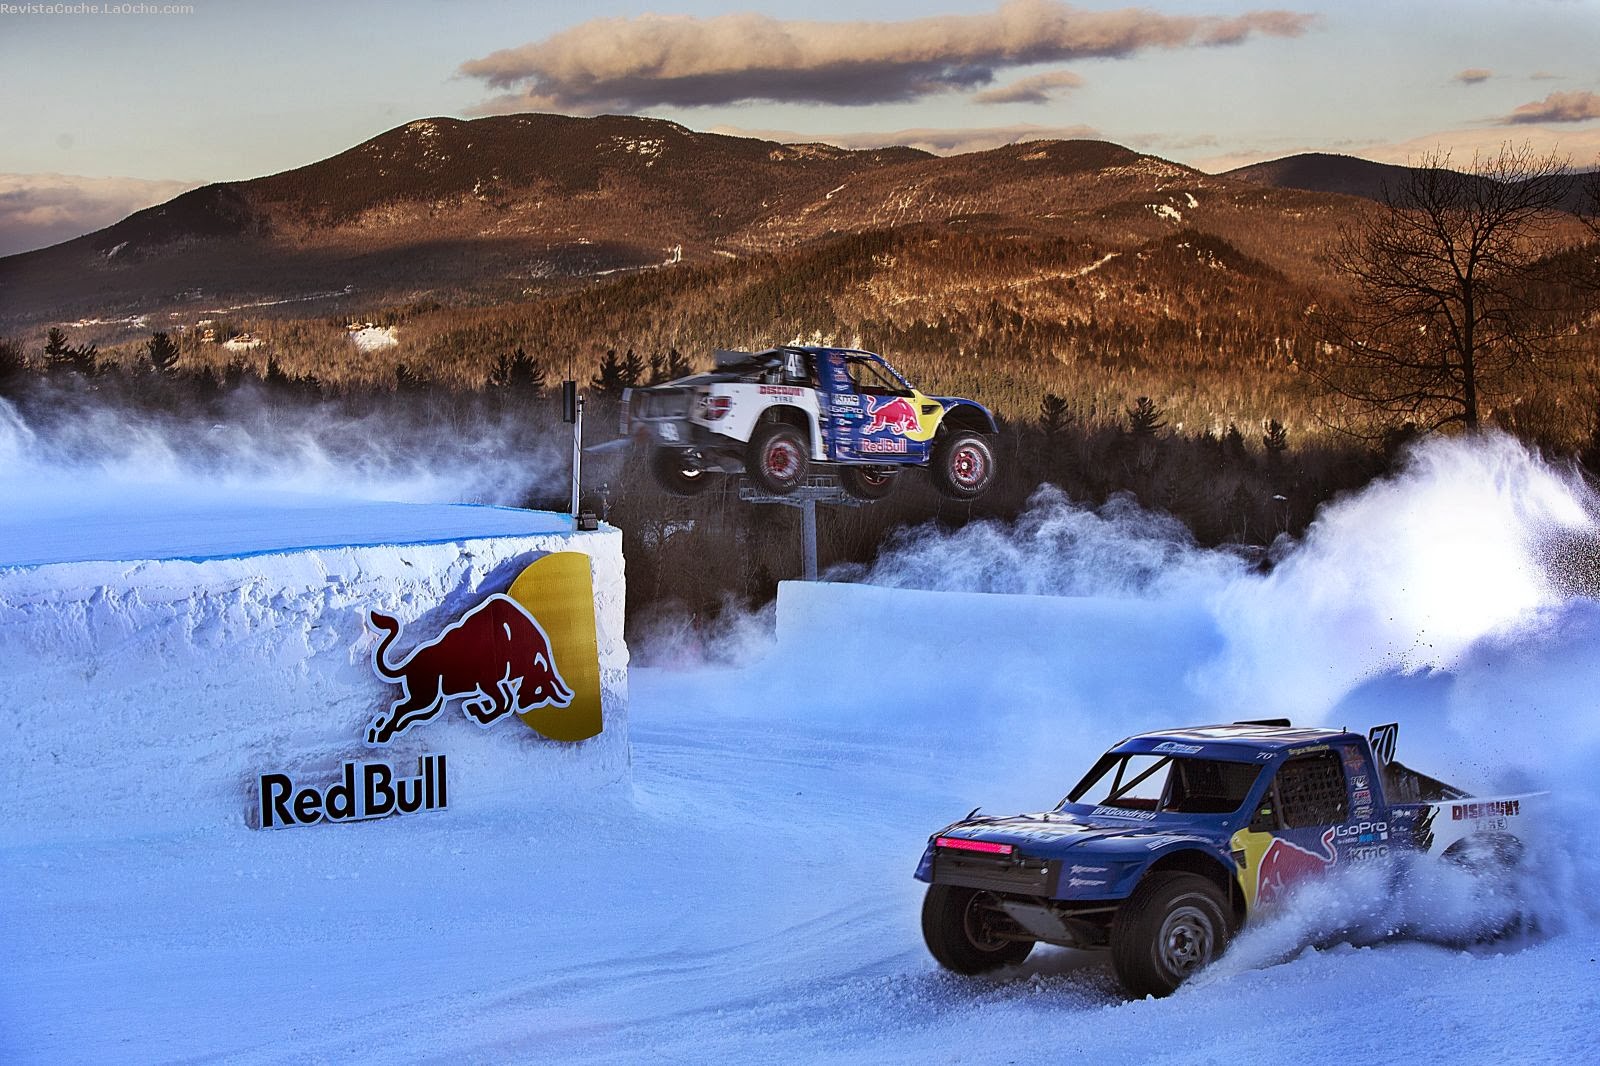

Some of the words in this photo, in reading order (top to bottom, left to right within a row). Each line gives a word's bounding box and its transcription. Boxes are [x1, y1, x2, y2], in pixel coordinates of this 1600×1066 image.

[862, 438, 884, 452] Red
[885, 438, 907, 452] Bull
[1370, 725, 1396, 766] 70
[1256, 752, 1273, 760] 70
[261, 762, 356, 828] Red
[364, 754, 448, 816] Bull
[1336, 821, 1388, 836] GoPro
